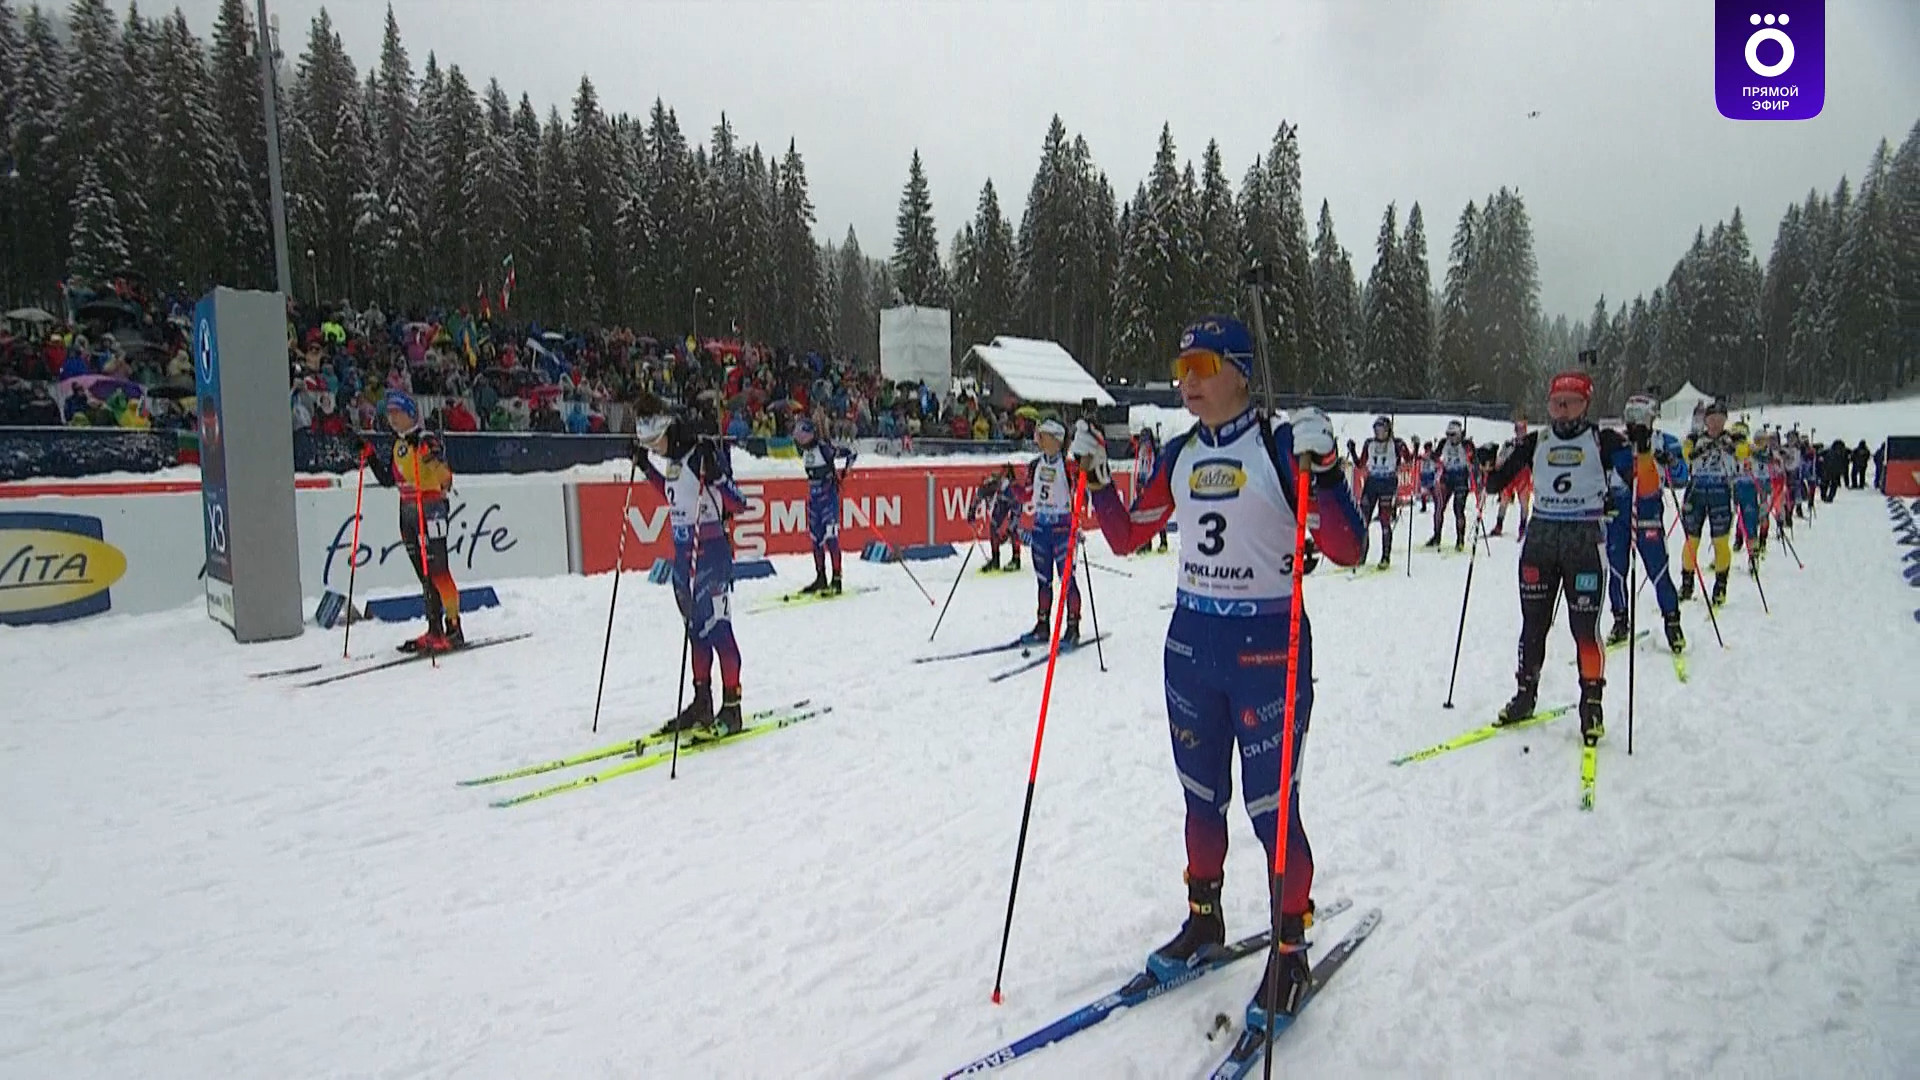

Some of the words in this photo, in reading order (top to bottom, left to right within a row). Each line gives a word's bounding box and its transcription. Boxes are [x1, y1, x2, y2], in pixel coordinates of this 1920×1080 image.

[1038, 485, 1051, 500] 5
[1553, 472, 1572, 494] 6
[666, 486, 675, 506] 2
[208, 503, 227, 553] X3
[1197, 511, 1227, 556] 3
[324, 513, 404, 586] for
[1184, 562, 1255, 580] POKLJUKA
[1279, 553, 1294, 575] 3
[722, 595, 729, 616] 2
[1243, 732, 1284, 758] CRAF
